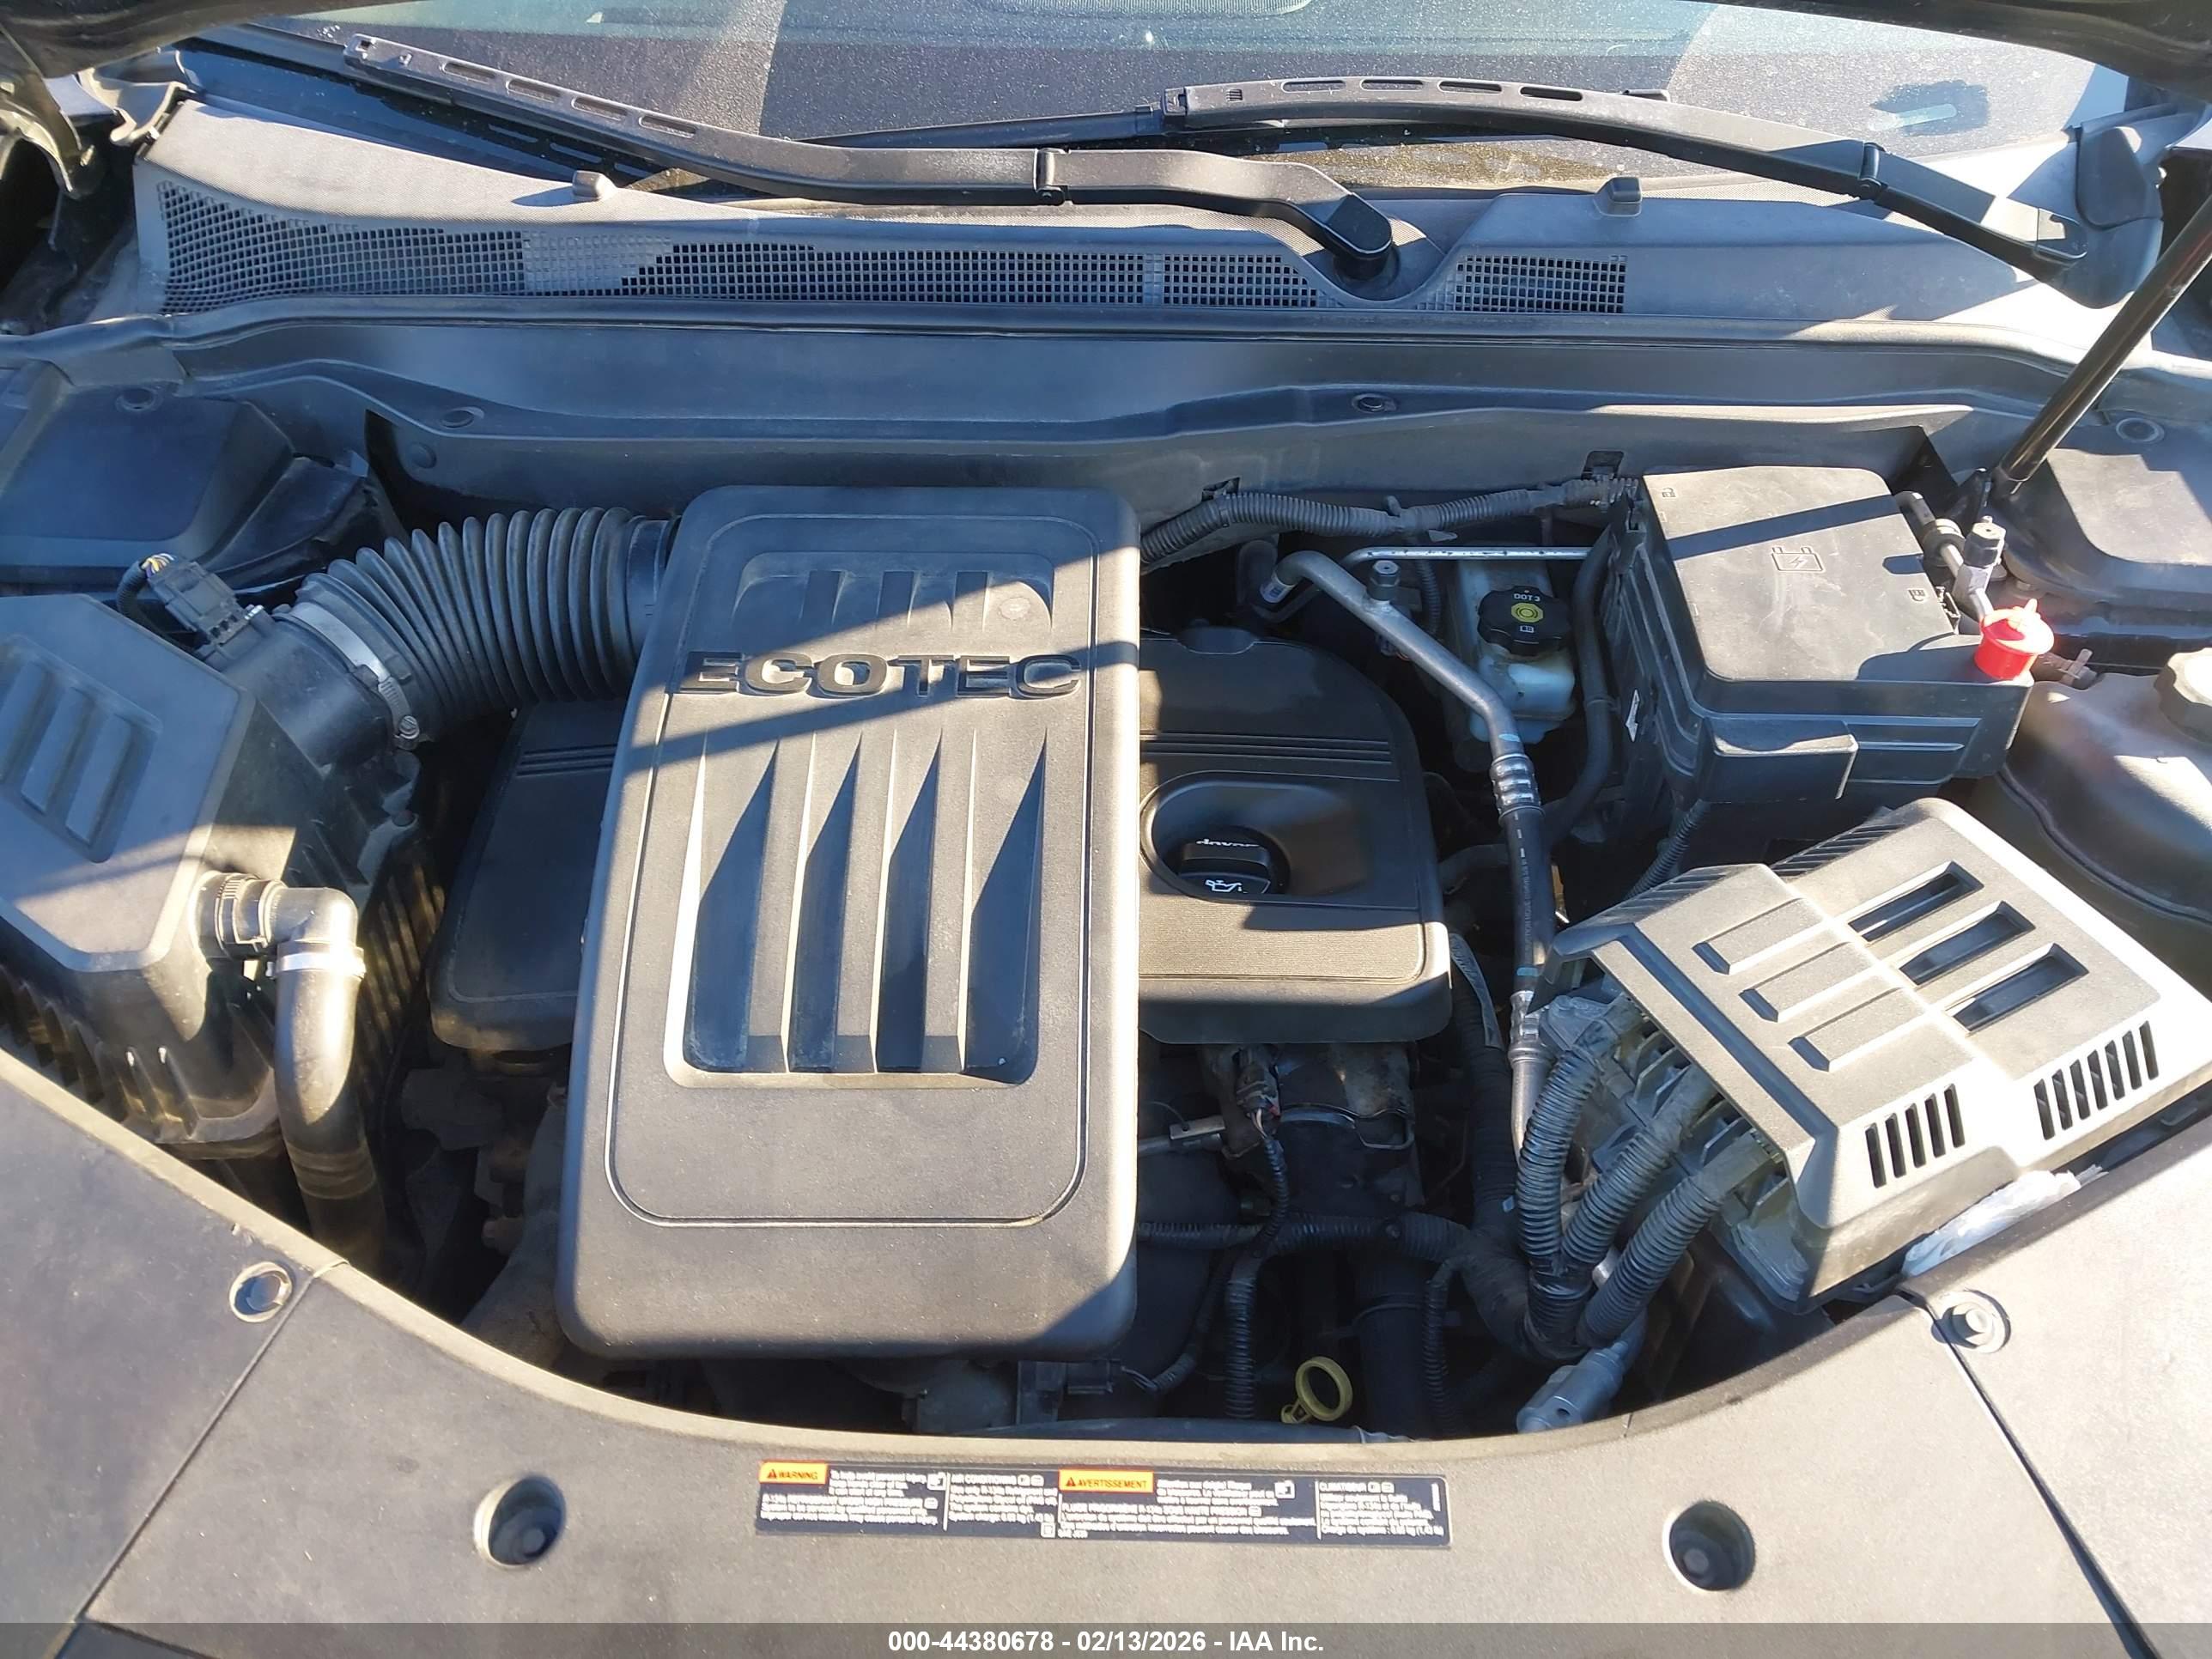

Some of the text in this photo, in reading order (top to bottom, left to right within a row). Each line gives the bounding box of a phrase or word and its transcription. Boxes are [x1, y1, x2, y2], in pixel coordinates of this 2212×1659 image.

[686, 651, 1081, 698] ECOTEC
[778, 1470, 818, 1480] WARNING
[1078, 1479, 1147, 1488] AVERTISSEMENT
